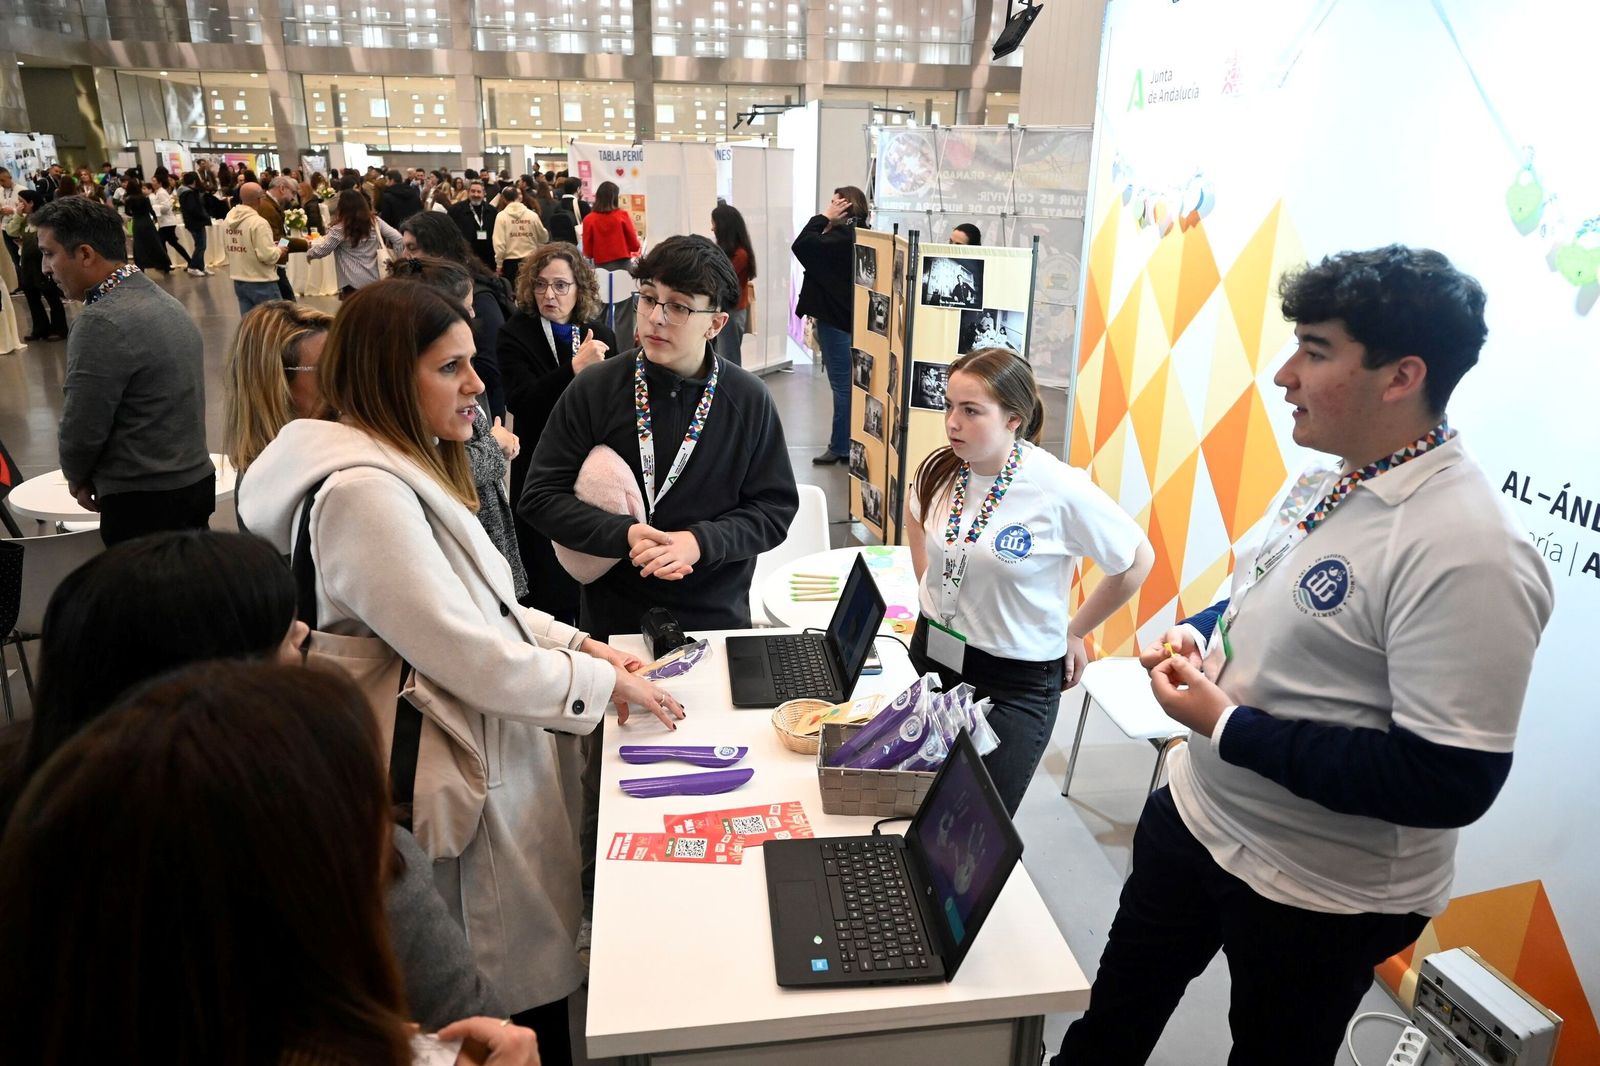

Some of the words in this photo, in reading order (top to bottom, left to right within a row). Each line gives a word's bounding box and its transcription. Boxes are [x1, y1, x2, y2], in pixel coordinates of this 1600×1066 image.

[1150, 68, 1173, 84] Junta
[1148, 90, 1158, 104] de
[598, 150, 622, 161] TABLA
[714, 149, 732, 161] NES
